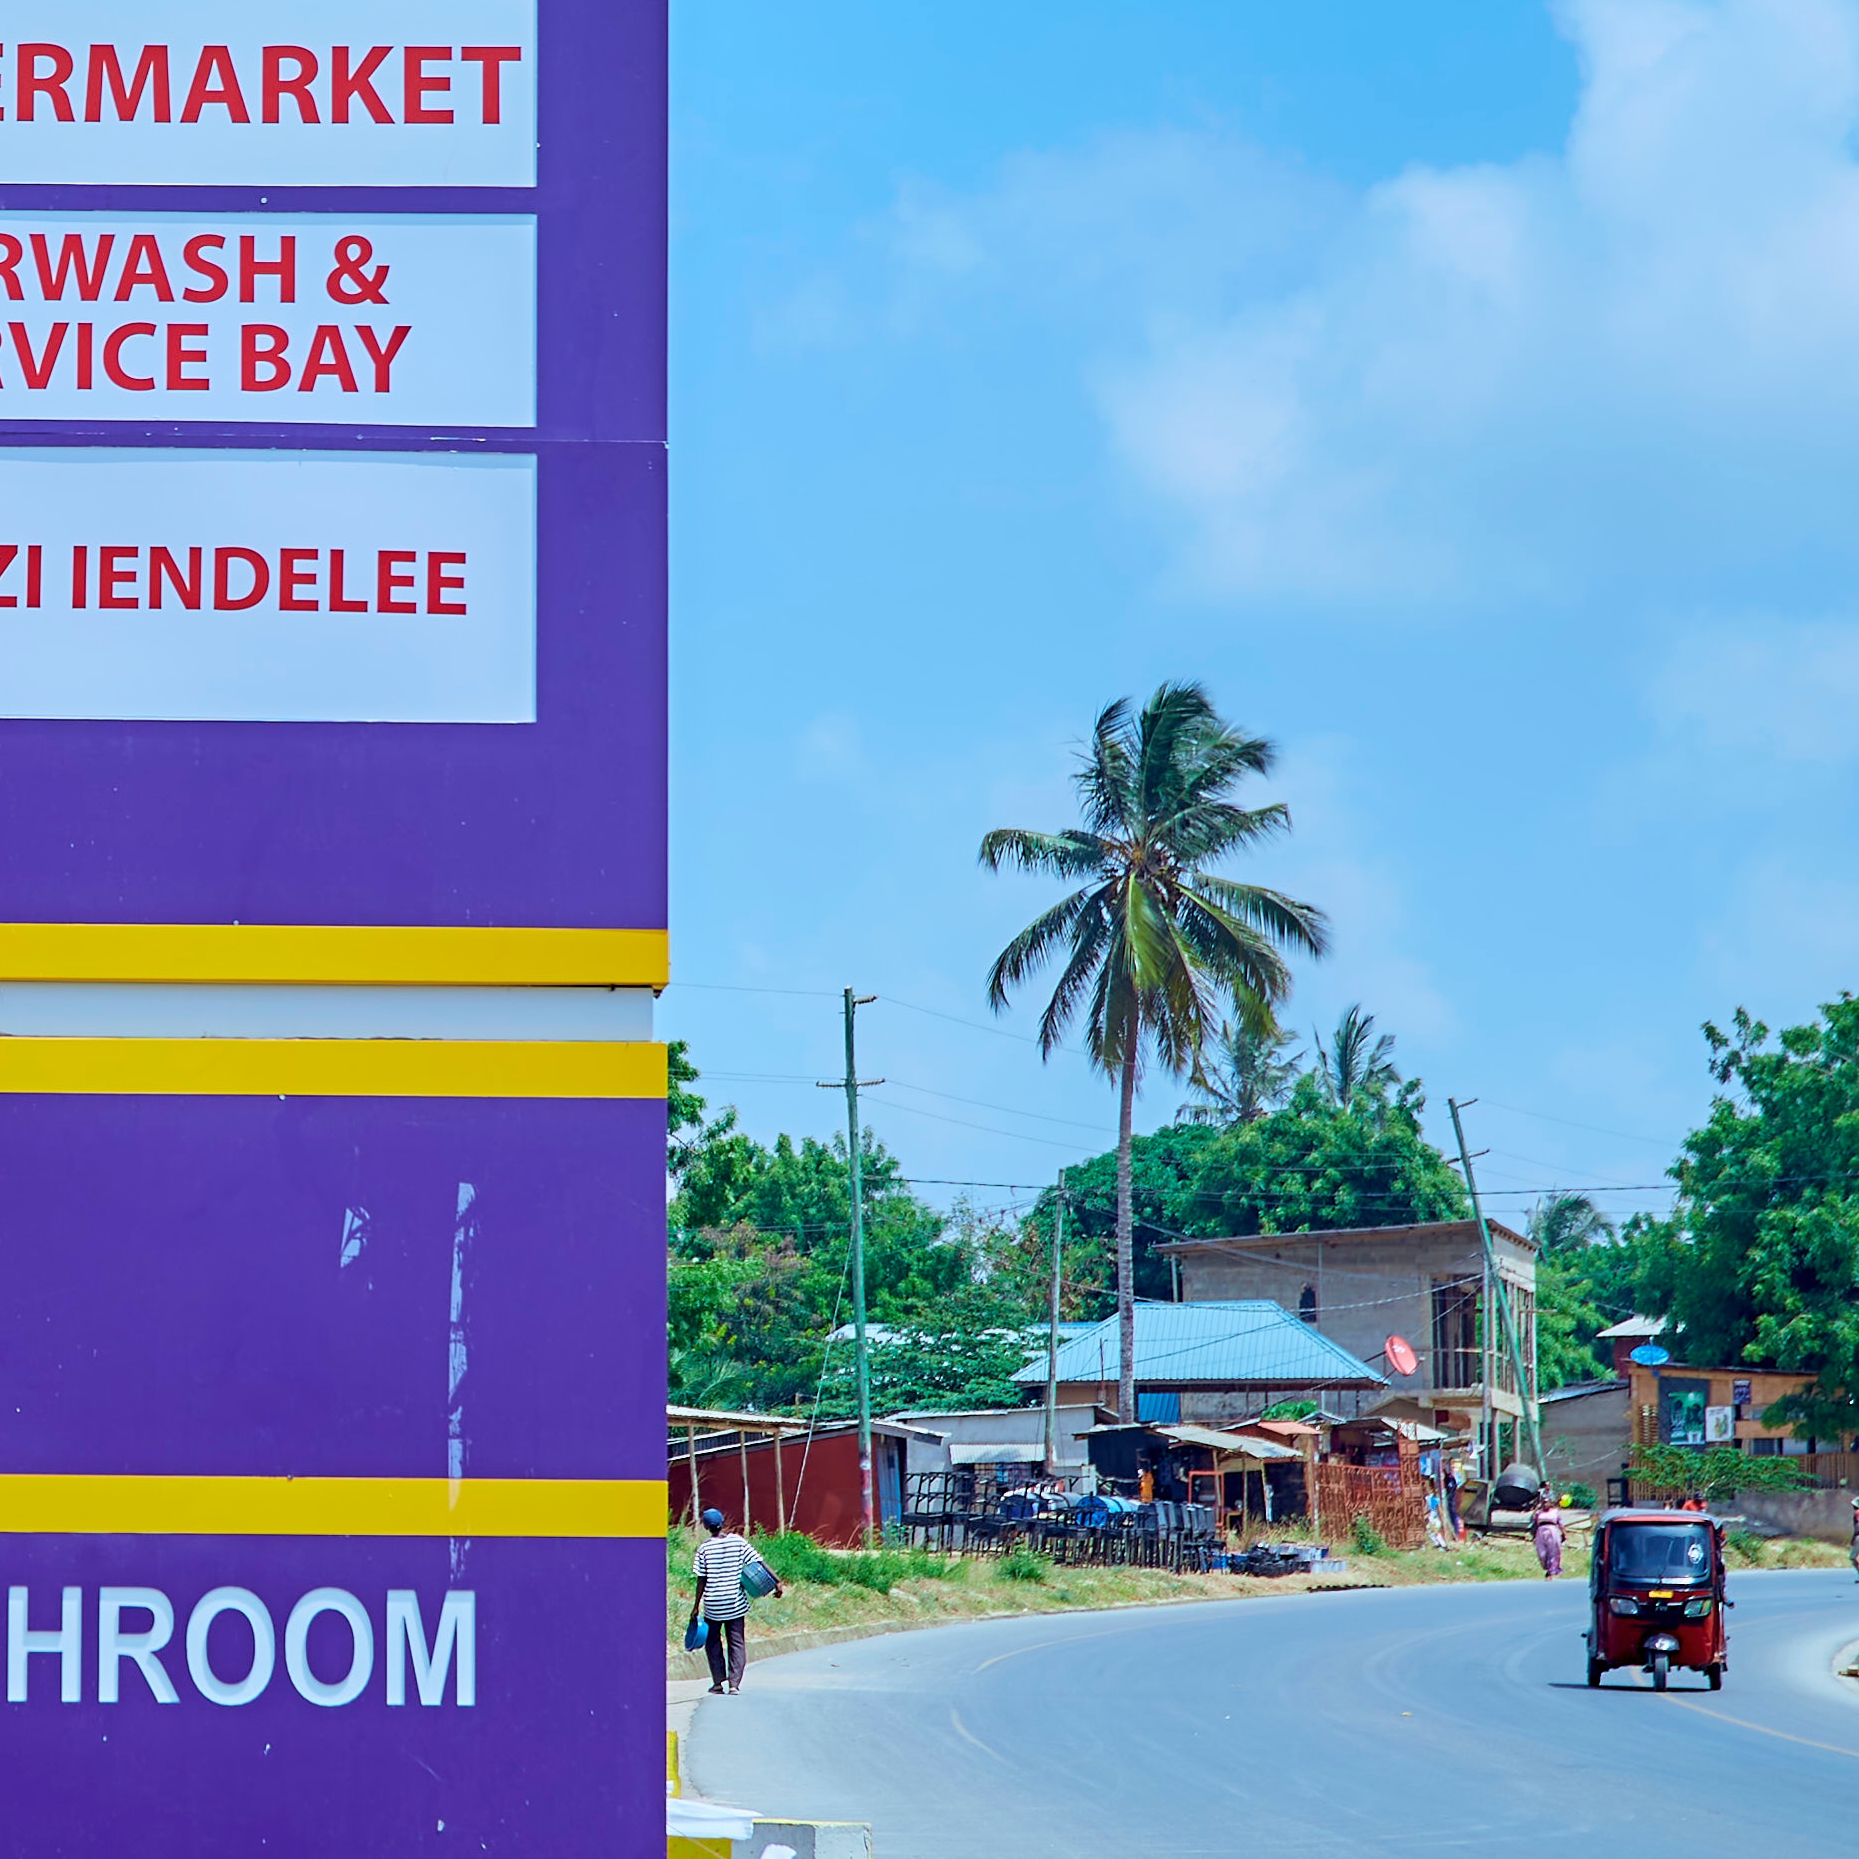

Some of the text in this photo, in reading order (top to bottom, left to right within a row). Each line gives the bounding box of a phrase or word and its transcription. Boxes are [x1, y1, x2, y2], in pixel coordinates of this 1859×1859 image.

[325, 234, 391, 305] &
[239, 323, 412, 394] BAY
[72, 544, 468, 616] IENDELEE
